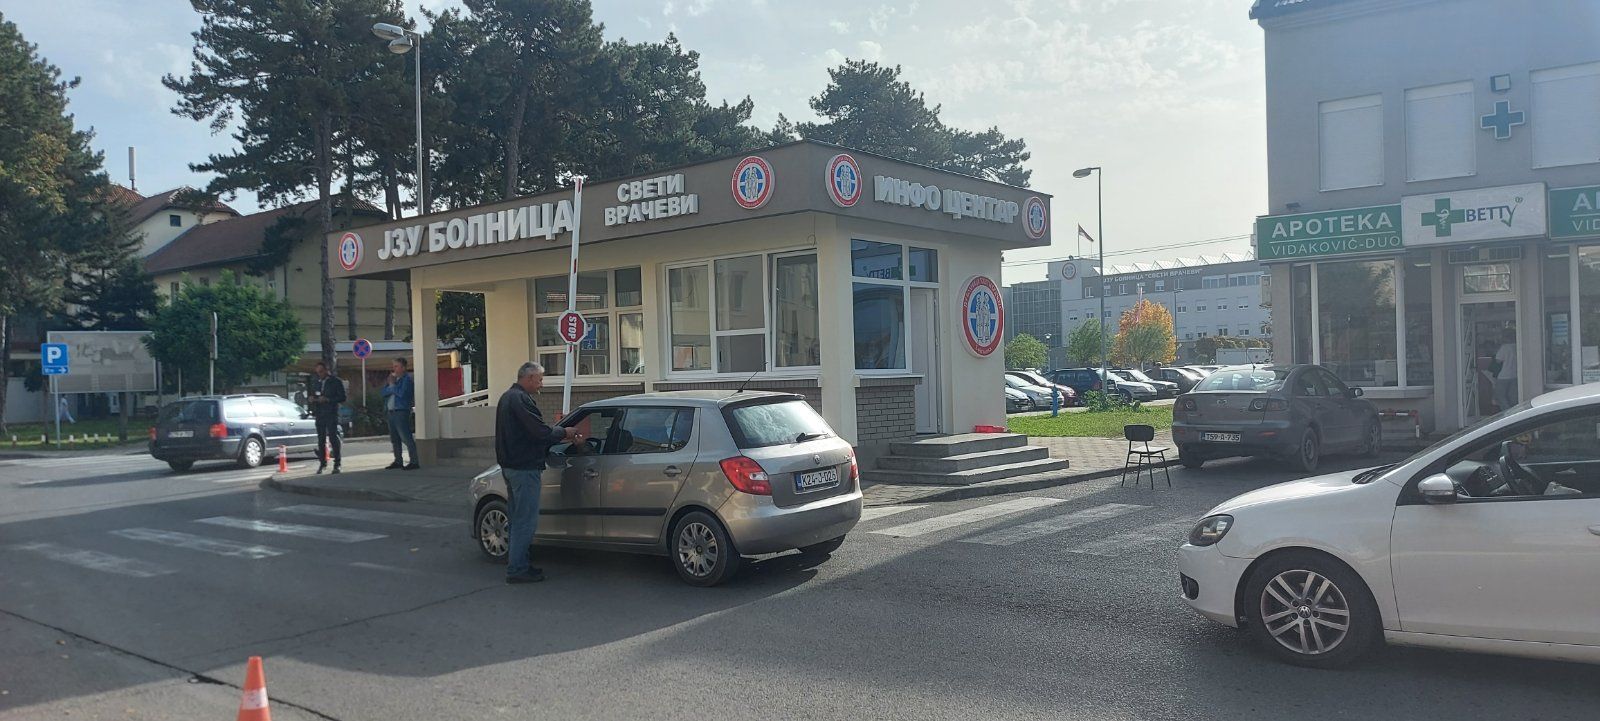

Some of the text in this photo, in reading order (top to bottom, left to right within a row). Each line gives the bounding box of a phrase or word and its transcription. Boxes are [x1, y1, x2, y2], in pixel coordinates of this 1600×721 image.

[617, 173, 684, 203] СВЕТИ
[873, 175, 941, 211] ИНФО
[942, 188, 1019, 224] ЦЕНТАР
[604, 193, 699, 227] ВРАЧЕВИ
[1466, 204, 1517, 227] BETTY
[377, 224, 424, 261] ЈЗУ
[428, 199, 574, 253] БОЛНИЦА
[1271, 211, 1393, 239] APOTEKA
[1271, 235, 1401, 256] VIDAKOVIĆ-DUO
[567, 315, 577, 339] STOP
[47, 346, 62, 364] P
